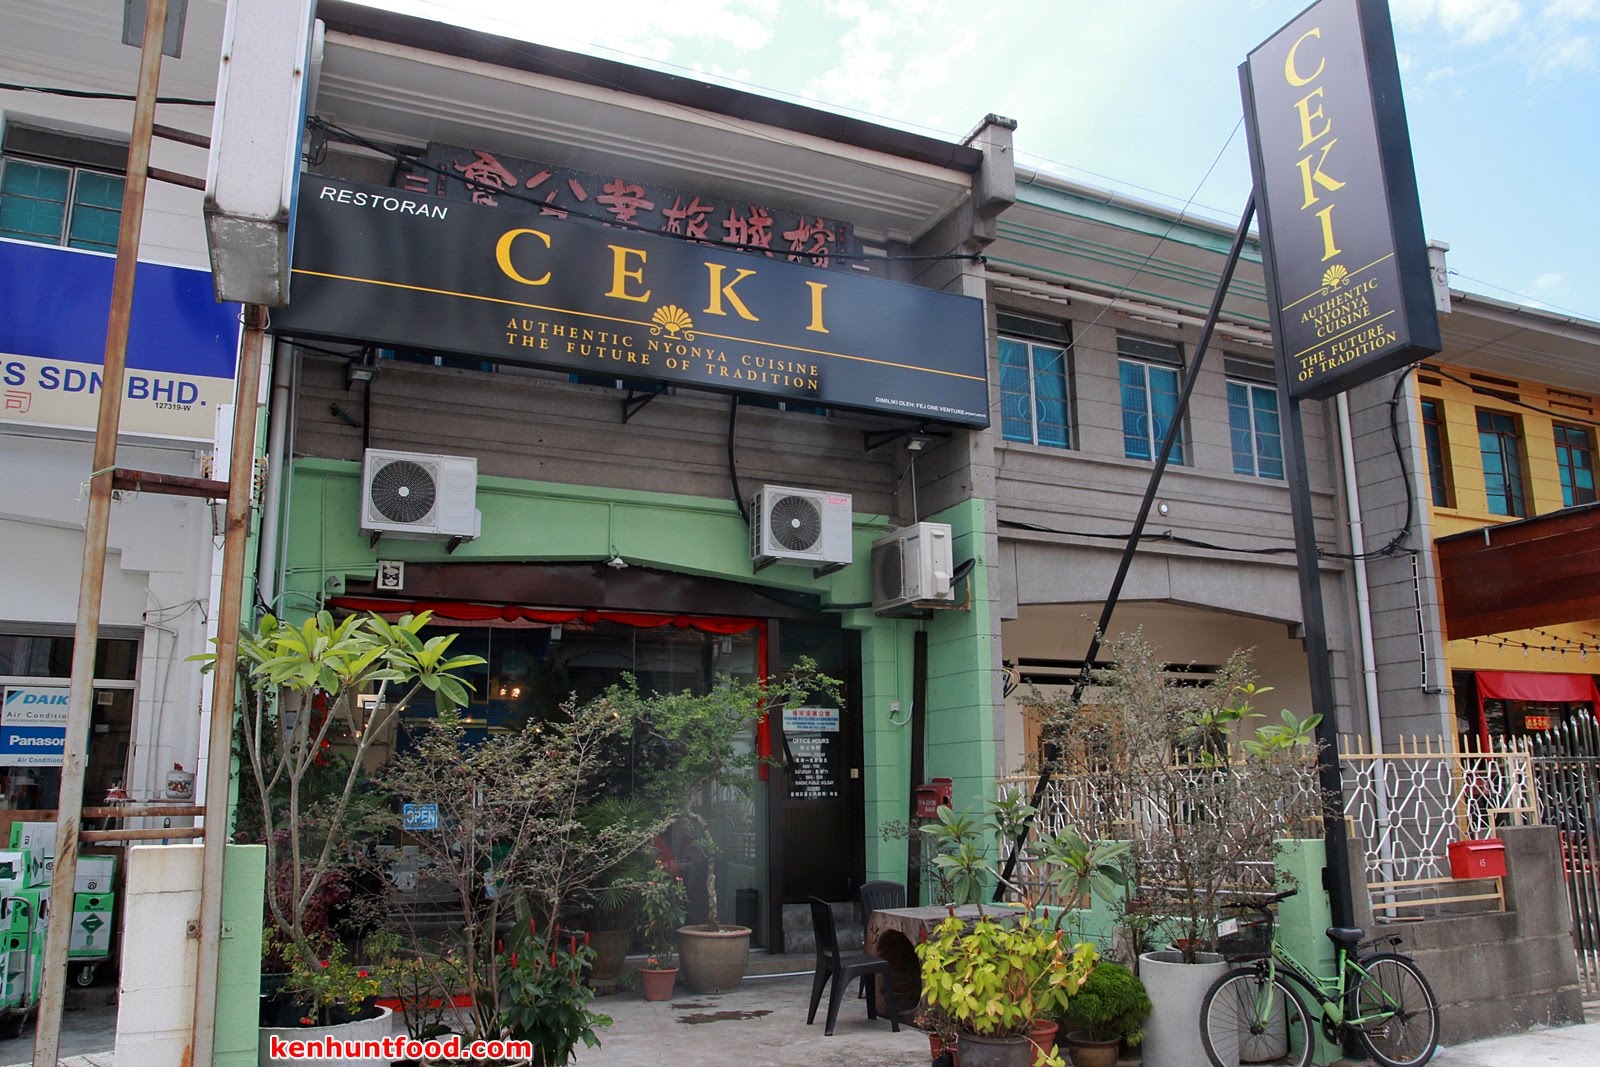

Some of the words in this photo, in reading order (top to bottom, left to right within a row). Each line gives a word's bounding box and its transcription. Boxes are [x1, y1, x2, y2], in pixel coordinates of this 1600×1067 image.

[1284, 27, 1347, 262] CEKI
[319, 186, 448, 220] RESTORAN
[495, 228, 830, 334] CEKI
[1301, 277, 1378, 323] AUTHENTIC
[1314, 295, 1368, 328] NYONYA
[1317, 306, 1371, 338] CUISINE
[506, 332, 549, 350] THE
[567, 342, 650, 365] FUTURE
[666, 357, 691, 371] OF
[706, 363, 818, 391] TRADITION
[507, 317, 633, 347] AUTHENTIC
[648, 339, 727, 361] NYONYA
[741, 355, 818, 376] CUISINE
[1298, 367, 1314, 382] OF
[1319, 330, 1396, 373] TRADITION
[1300, 350, 1326, 369] THE
[1331, 323, 1385, 356] FUTURE
[4, 390, 32, 413] 司
[127, 376, 207, 406] BHD.
[155, 402, 191, 411] 127319-W
[875, 397, 898, 406] DIMILIKI
[898, 400, 916, 408] OLEH:
[926, 404, 939, 412] ONE
[939, 405, 965, 415] VENTURE
[406, 810, 435, 823] OPEN
